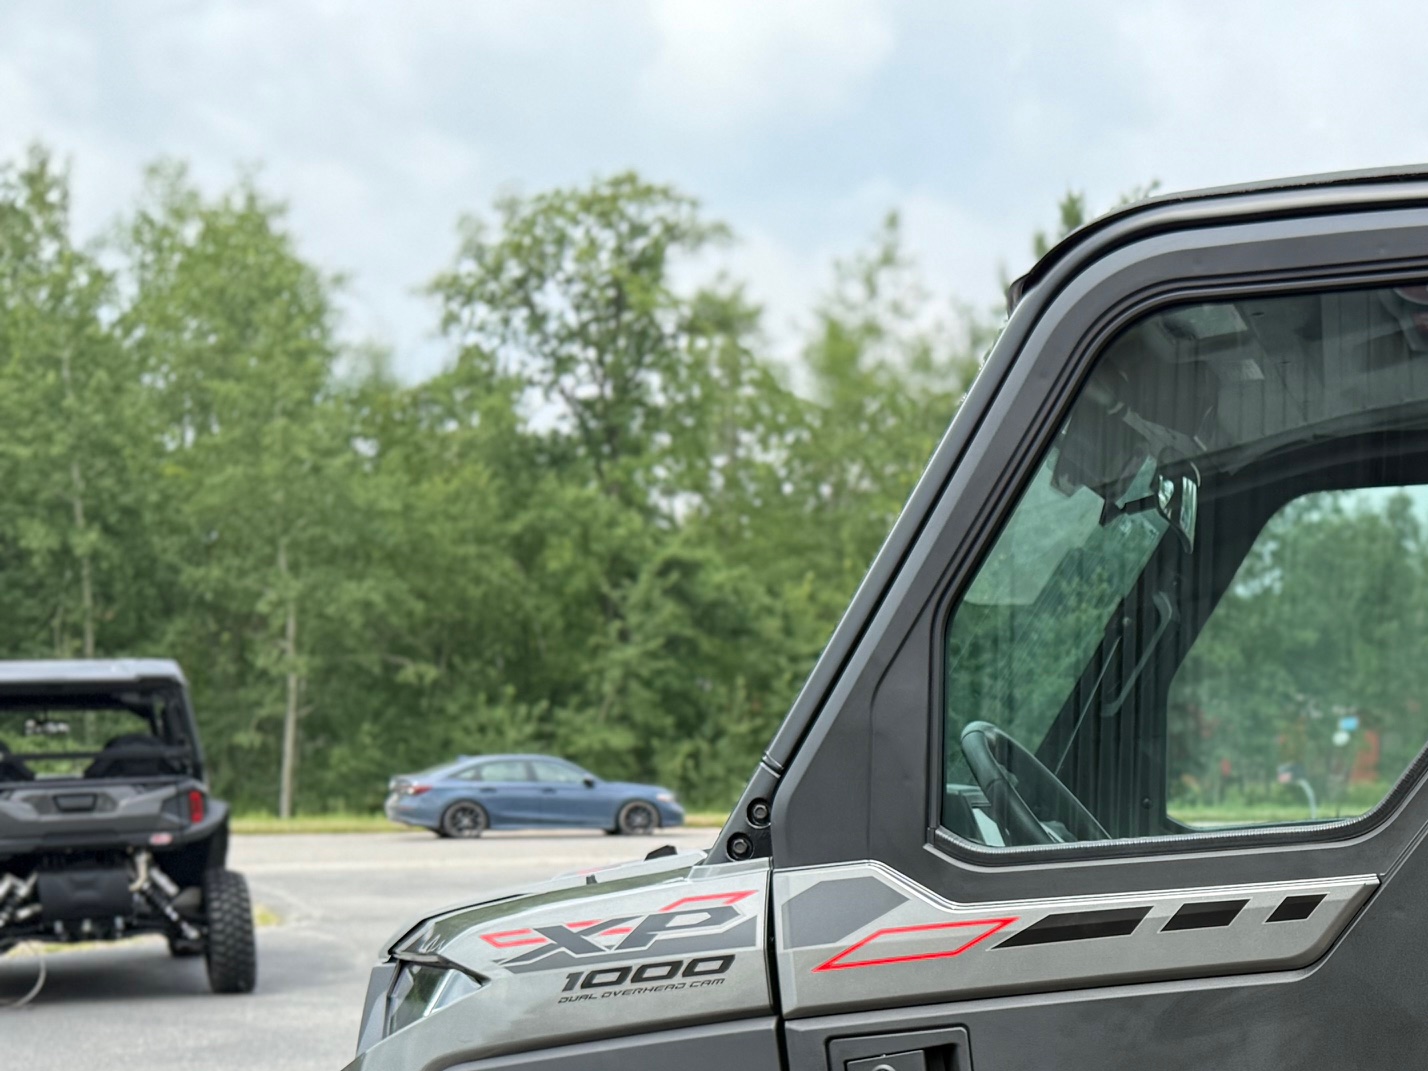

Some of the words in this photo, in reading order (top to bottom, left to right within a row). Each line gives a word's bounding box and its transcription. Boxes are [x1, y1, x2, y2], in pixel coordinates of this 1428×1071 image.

[493, 905, 743, 966] XP
[557, 992, 598, 1004] DUAL
[601, 982, 687, 999] OVERHEAD
[689, 977, 726, 988] CAM
[561, 954, 736, 992] 1000
